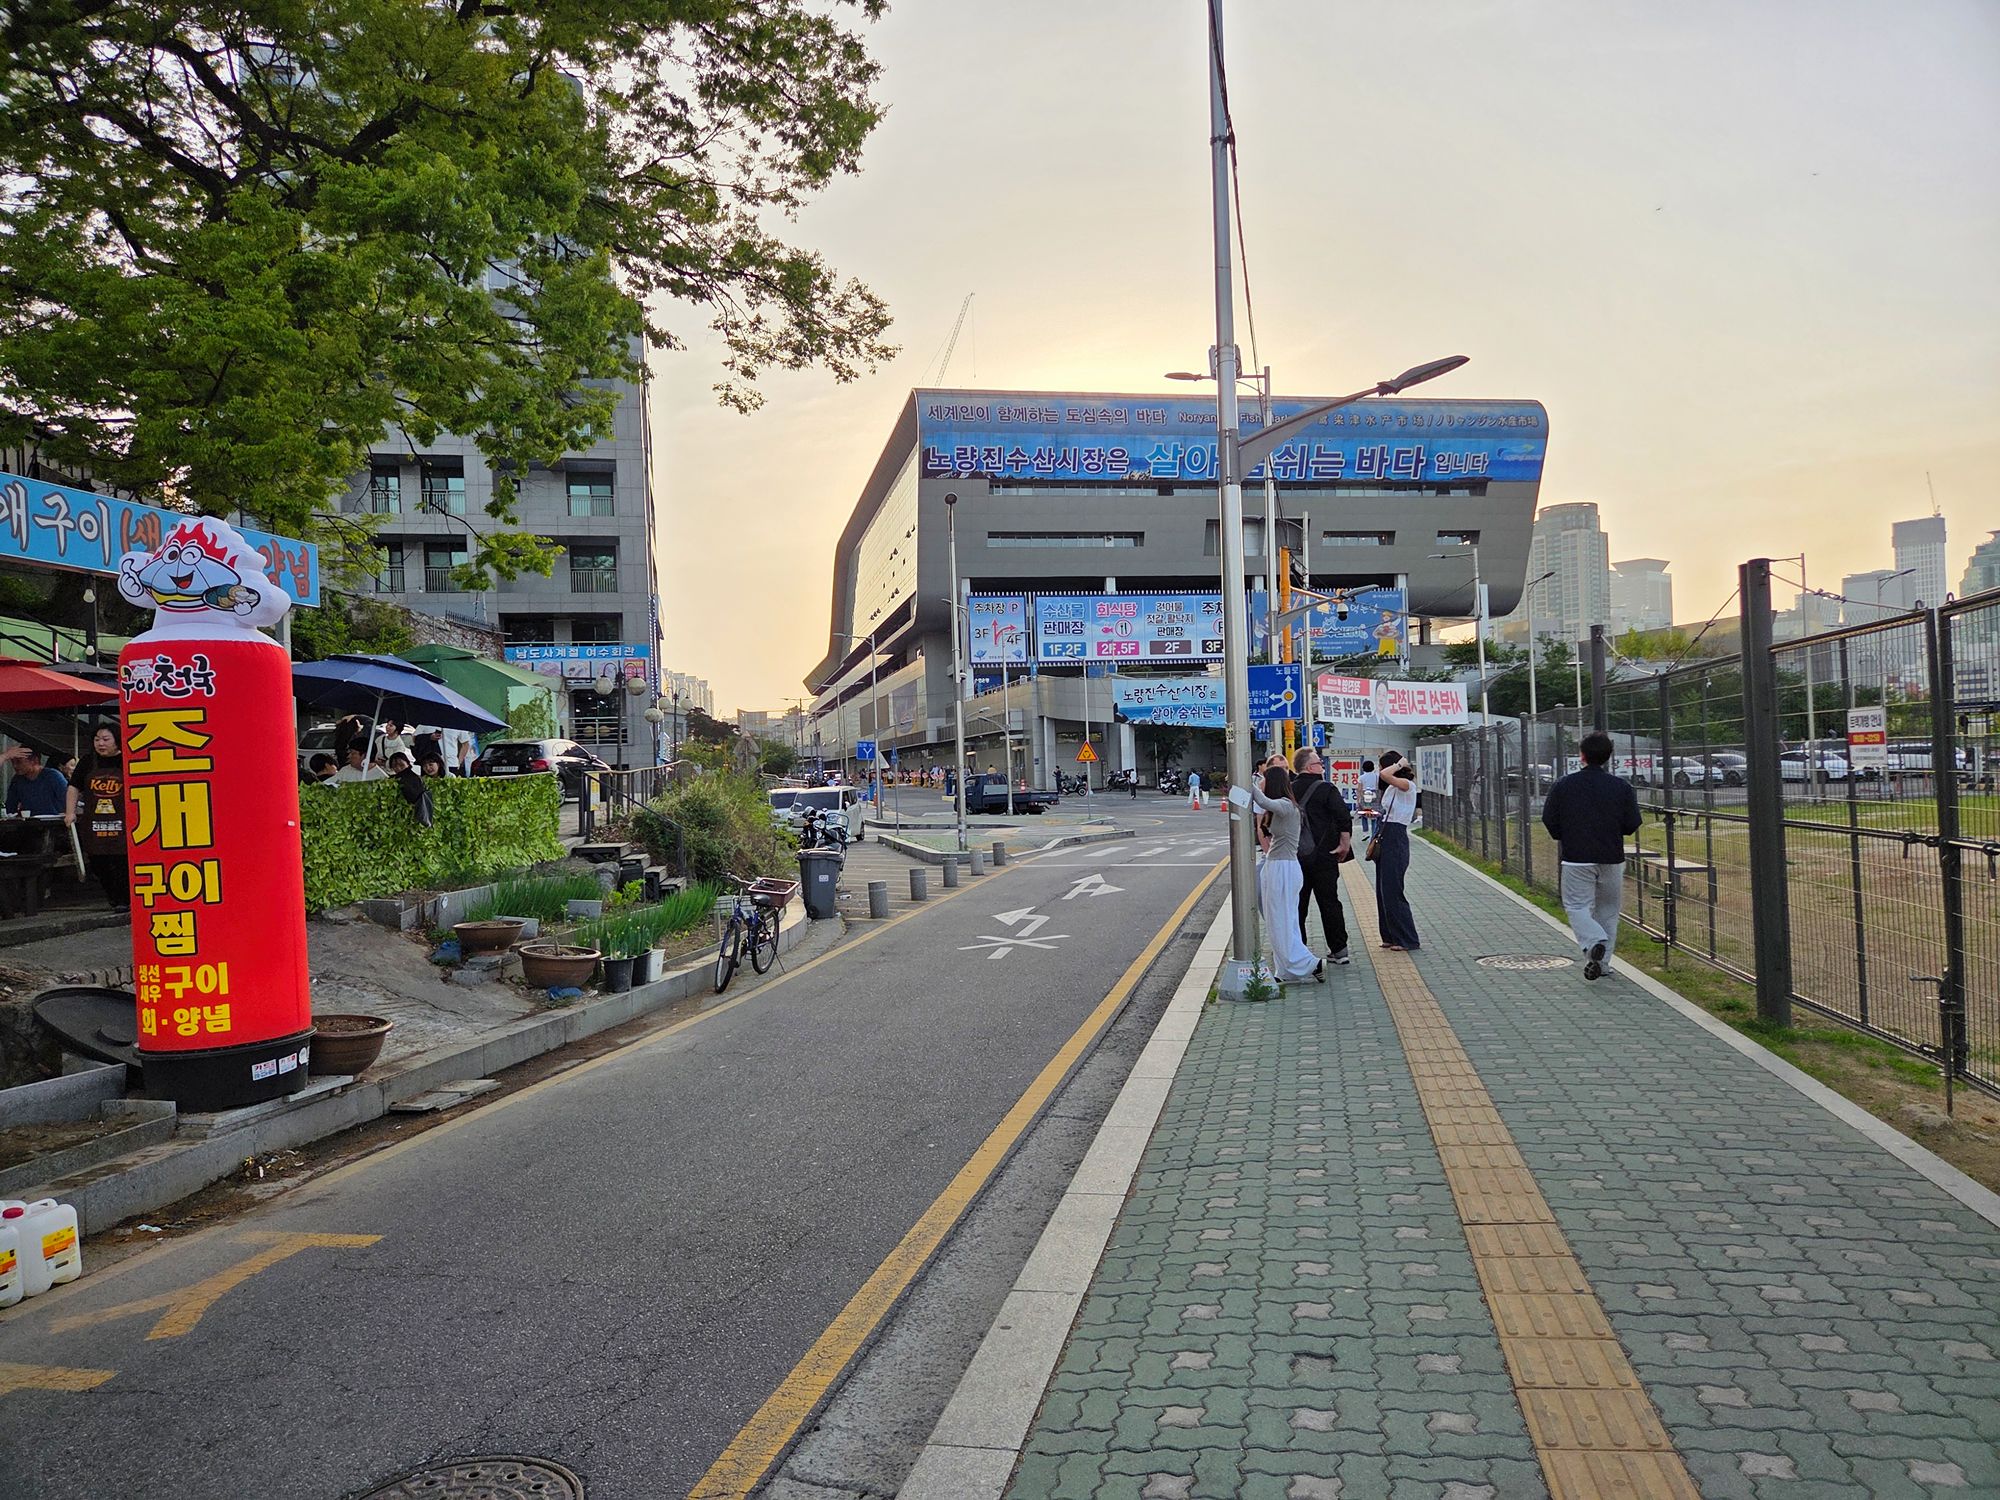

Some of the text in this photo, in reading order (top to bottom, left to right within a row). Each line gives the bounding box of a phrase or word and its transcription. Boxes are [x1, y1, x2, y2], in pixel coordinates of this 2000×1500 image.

[928, 405, 990, 422] 세계인이
[997, 406, 1059, 423] 함께하는
[1066, 407, 1128, 425] 도심속의
[1136, 408, 1167, 425] 바다
[1179, 412, 1217, 424] Noryan
[1240, 413, 1262, 423] Fish
[927, 446, 1129, 474] 노량진수산시장은
[1146, 443, 1219, 478] 살아
[1355, 444, 1427, 480] 바다
[1434, 452, 1489, 474] 입니다
[974, 603, 1005, 615] 주차장
[1043, 602, 1084, 618] 수산물
[1097, 602, 1137, 617] 회식당
[974, 628, 989, 639] 3F
[1043, 621, 1085, 635] 판매장
[1157, 626, 1184, 637] 판매장
[1007, 635, 1021, 644] 4F
[1164, 641, 1180, 653] 2F
[516, 646, 635, 660] 남도사계절 여수회관
[1048, 644, 1082, 655] 1F,2F
[1276, 666, 1299, 675] 노들로
[1151, 707, 1175, 721] 살아
[1178, 706, 1213, 720] 숨쉬는
[90, 779, 123, 794] Kelly
[1332, 773, 1359, 786] 주차장
[134, 859, 223, 908] 구이
[150, 910, 198, 957] 찜
[139, 964, 161, 983] 생선
[164, 961, 229, 999] 구이
[140, 985, 162, 1003] 새우
